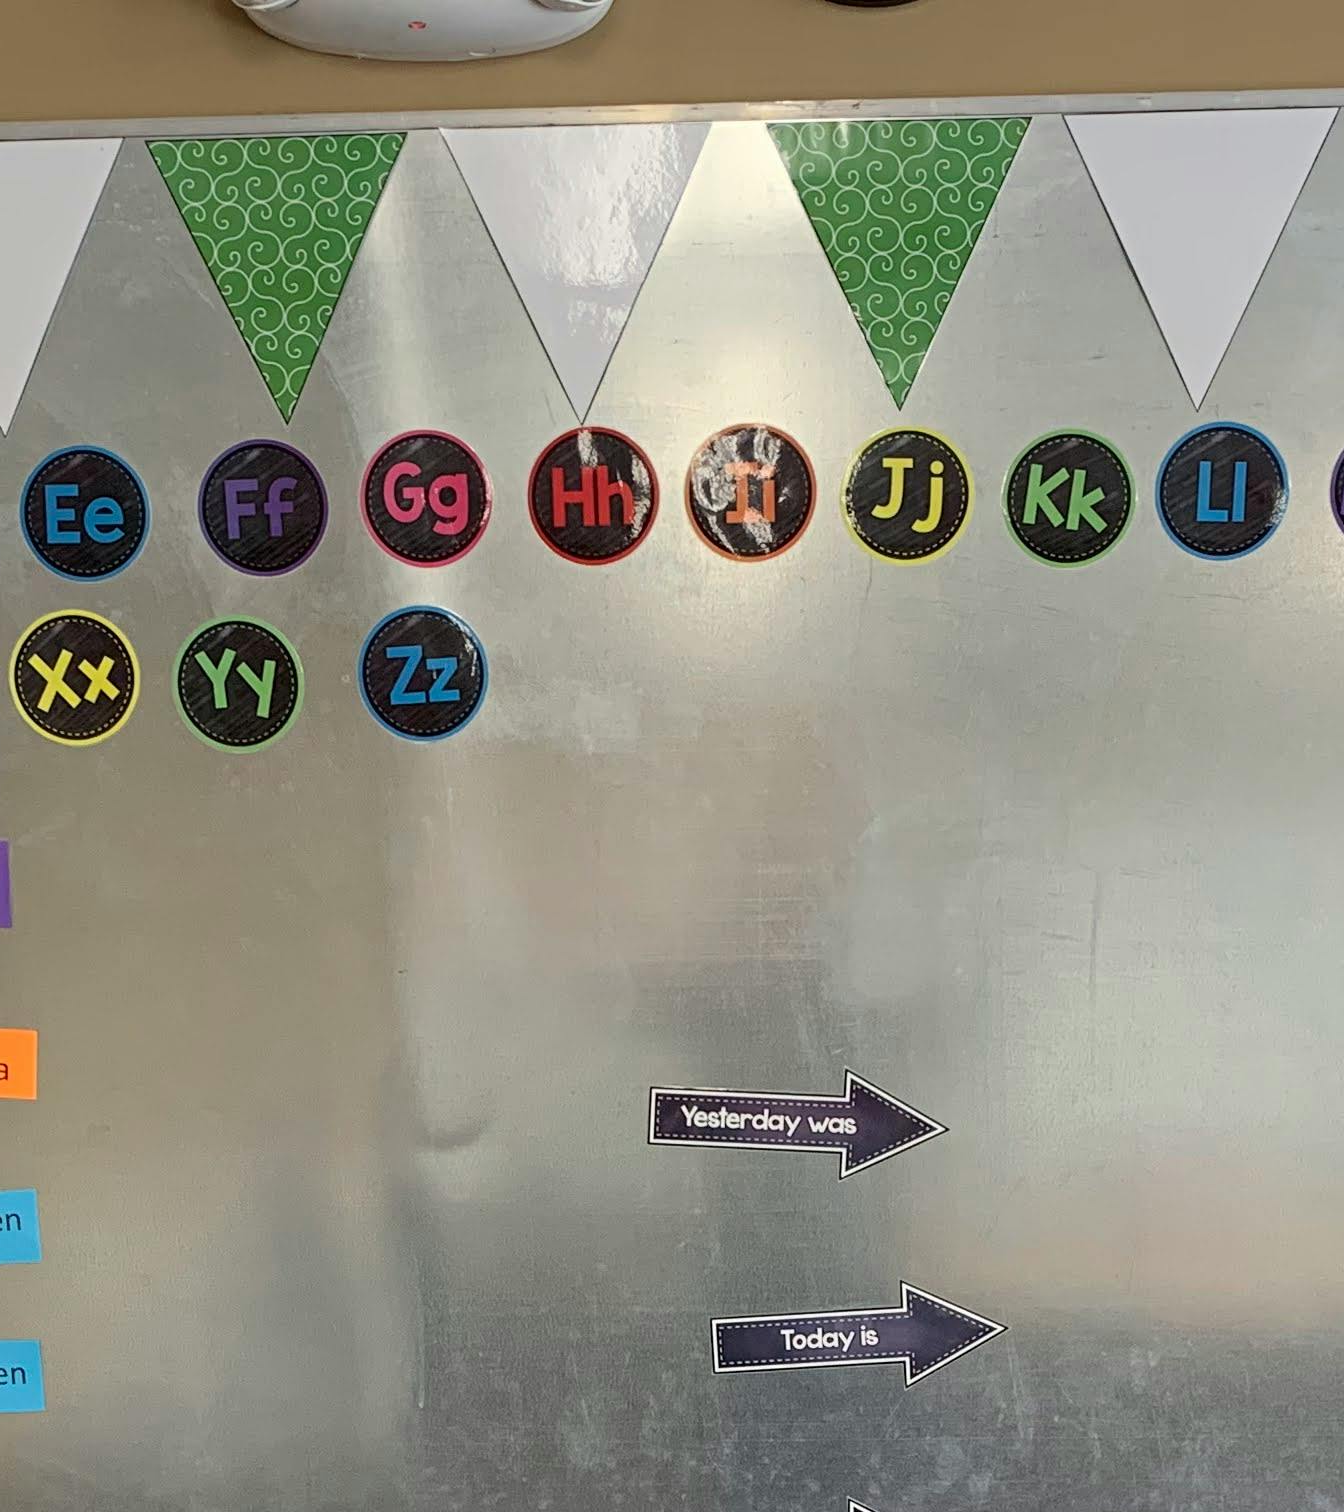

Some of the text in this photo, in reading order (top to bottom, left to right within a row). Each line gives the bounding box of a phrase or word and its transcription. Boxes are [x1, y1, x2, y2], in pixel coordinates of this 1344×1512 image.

[44, 484, 125, 545] Ee
[224, 477, 298, 539] Ff
[383, 462, 469, 534] Gg
[552, 467, 634, 528] Hh
[723, 461, 776, 525] Ii
[871, 457, 944, 533] Jj
[1022, 463, 1107, 533] Kk
[1196, 460, 1245, 523] Ll
[28, 648, 120, 714] Xx
[195, 647, 277, 719] Yy
[386, 644, 460, 706] Zz
[681, 1104, 856, 1136] Yesterday was
[780, 1325, 878, 1352] Today is
